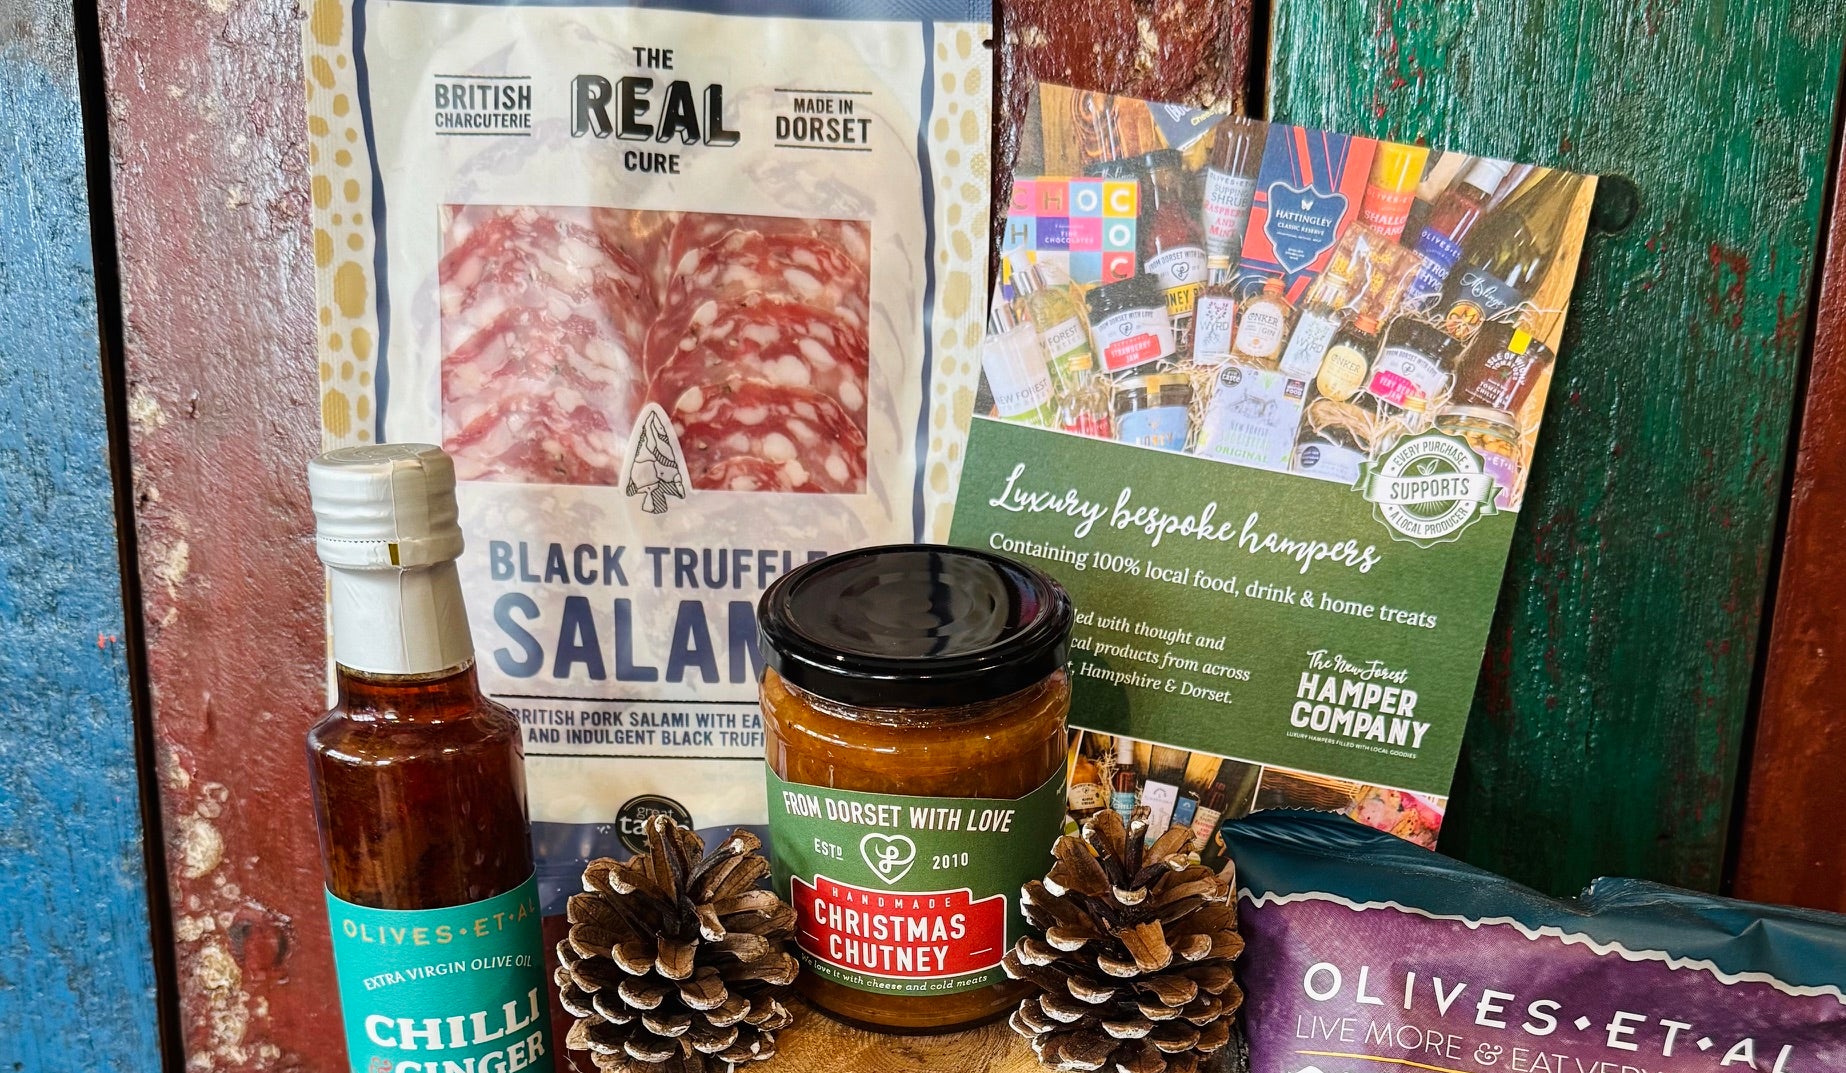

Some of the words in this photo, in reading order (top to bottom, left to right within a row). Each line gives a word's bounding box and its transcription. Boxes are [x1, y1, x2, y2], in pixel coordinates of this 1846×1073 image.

[633, 47, 673, 70] THE
[435, 84, 531, 111] BRITISH
[571, 75, 740, 147] REAL
[794, 98, 833, 114] MADE
[838, 99, 853, 115] IN
[435, 112, 531, 128] CHARCUTERIE
[776, 116, 872, 144] DORSET
[624, 151, 680, 174] CURE
[1276, 210, 1332, 227] HATTINGLEY
[1393, 444, 1423, 467] EVERY
[1423, 441, 1468, 466] PURCHASE
[1390, 478, 1470, 500] SUPPORTS
[989, 462, 1109, 539] Luxury
[1109, 486, 1236, 548] bespoke
[1238, 512, 1381, 575] hampers
[1396, 517, 1421, 534] LOCAL
[1425, 508, 1468, 535] PRODUCER
[489, 540, 629, 587] BLACK
[989, 533, 1089, 571] Containing
[1093, 551, 1141, 577] 100%
[1145, 561, 1190, 587] local
[1193, 568, 1241, 597] food,
[1245, 580, 1296, 606] drink
[1300, 589, 1315, 609] &
[1320, 592, 1375, 620] home
[1379, 604, 1438, 631] treats
[1097, 611, 1131, 634] with
[1134, 614, 1192, 648] thought
[1195, 632, 1225, 652] and
[1094, 639, 1160, 667] products
[1159, 652, 1198, 675] from
[1201, 663, 1250, 683] across
[1307, 649, 1332, 670] The
[1333, 654, 1363, 676] New
[1359, 659, 1409, 685] Forest
[1079, 663, 1161, 692] Hampshire
[1164, 677, 1178, 694] &
[1181, 680, 1233, 706] Dorset.
[1296, 672, 1418, 718] HAMPER
[581, 711, 622, 726] PORK
[629, 712, 690, 728] SALAMI
[696, 713, 738, 728] WITH
[1290, 701, 1431, 749] COMPANY
[528, 728, 559, 744] AND
[567, 729, 656, 745] INDULGENT
[661, 731, 713, 746] BLACK
[1287, 731, 1308, 739] LUXURY
[1308, 734, 1335, 744] HAMPERS
[1336, 739, 1355, 748] FILLED
[1355, 743, 1370, 751] WITH
[1370, 746, 1389, 754] LOCAL
[1390, 749, 1416, 759] GOODIES
[782, 790, 822, 819] FROM
[826, 798, 902, 828] DORSET
[909, 806, 962, 831] WITH
[966, 809, 1015, 833] LOVE
[932, 852, 968, 870] 2010
[832, 886, 951, 909] HANDMADE
[814, 898, 966, 942] CHRISTMAS
[829, 934, 949, 972] CHUTNEY
[363, 969, 406, 991] EXTRA
[406, 960, 466, 980] VIRGIN
[471, 955, 513, 970] OLIVE
[515, 954, 532, 967] OIL
[814, 961, 832, 976] love
[833, 968, 841, 978] it
[843, 971, 864, 986] with
[867, 979, 903, 990] cheese
[906, 981, 927, 992] and
[930, 979, 953, 990] cold
[956, 974, 988, 987] meats
[365, 987, 540, 1050] CHILLI
[1295, 1014, 1358, 1043] LIVE
[1364, 1016, 1462, 1061] MORE
[1473, 1041, 1503, 1066] &
